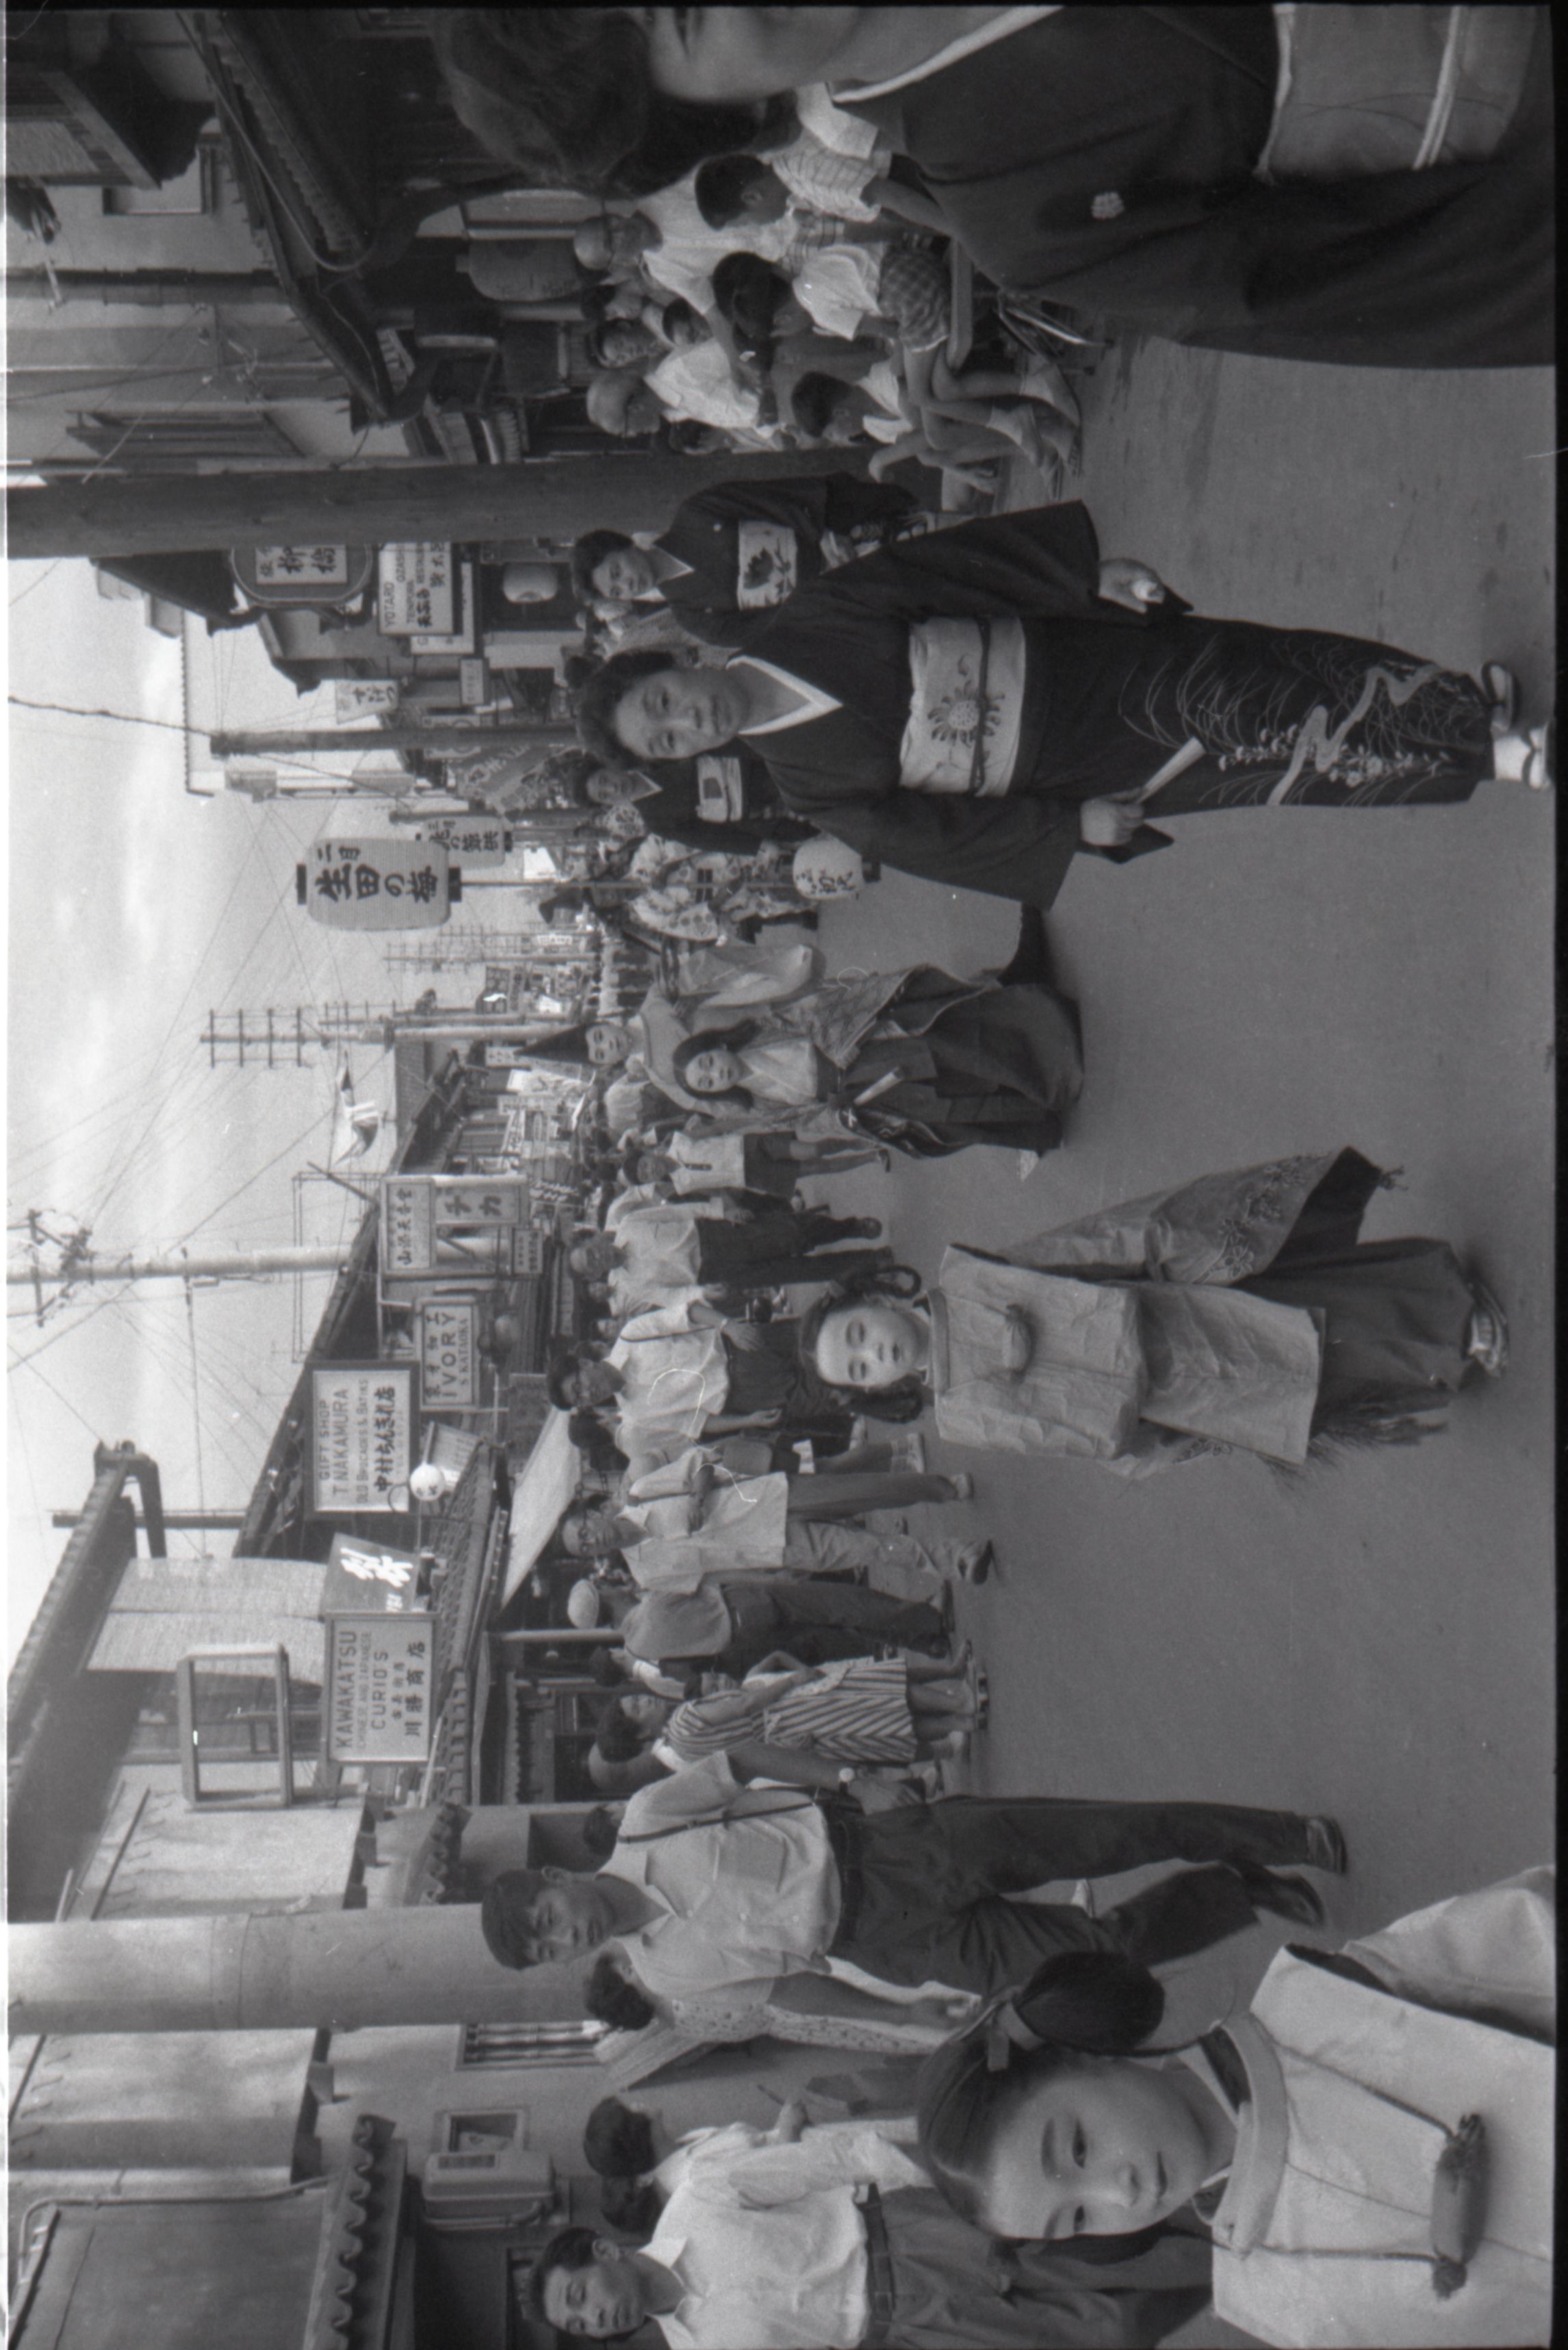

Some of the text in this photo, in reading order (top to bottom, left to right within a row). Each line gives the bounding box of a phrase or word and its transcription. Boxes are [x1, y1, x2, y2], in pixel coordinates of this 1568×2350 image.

[383, 582, 396, 628] YOTARO
[318, 844, 360, 863] 二月
[315, 863, 438, 903] 生田の梅
[441, 1312, 457, 1397] IVORY
[459, 1318, 469, 1373] KATAOKA
[319, 1400, 330, 1481] GIFT SHOP
[333, 1389, 349, 1481] NAKAMURA
[359, 1631, 372, 1681] JAPANESE
[336, 1631, 357, 1749] KAWAKATSU
[357, 1706, 368, 1750] CHINESE
